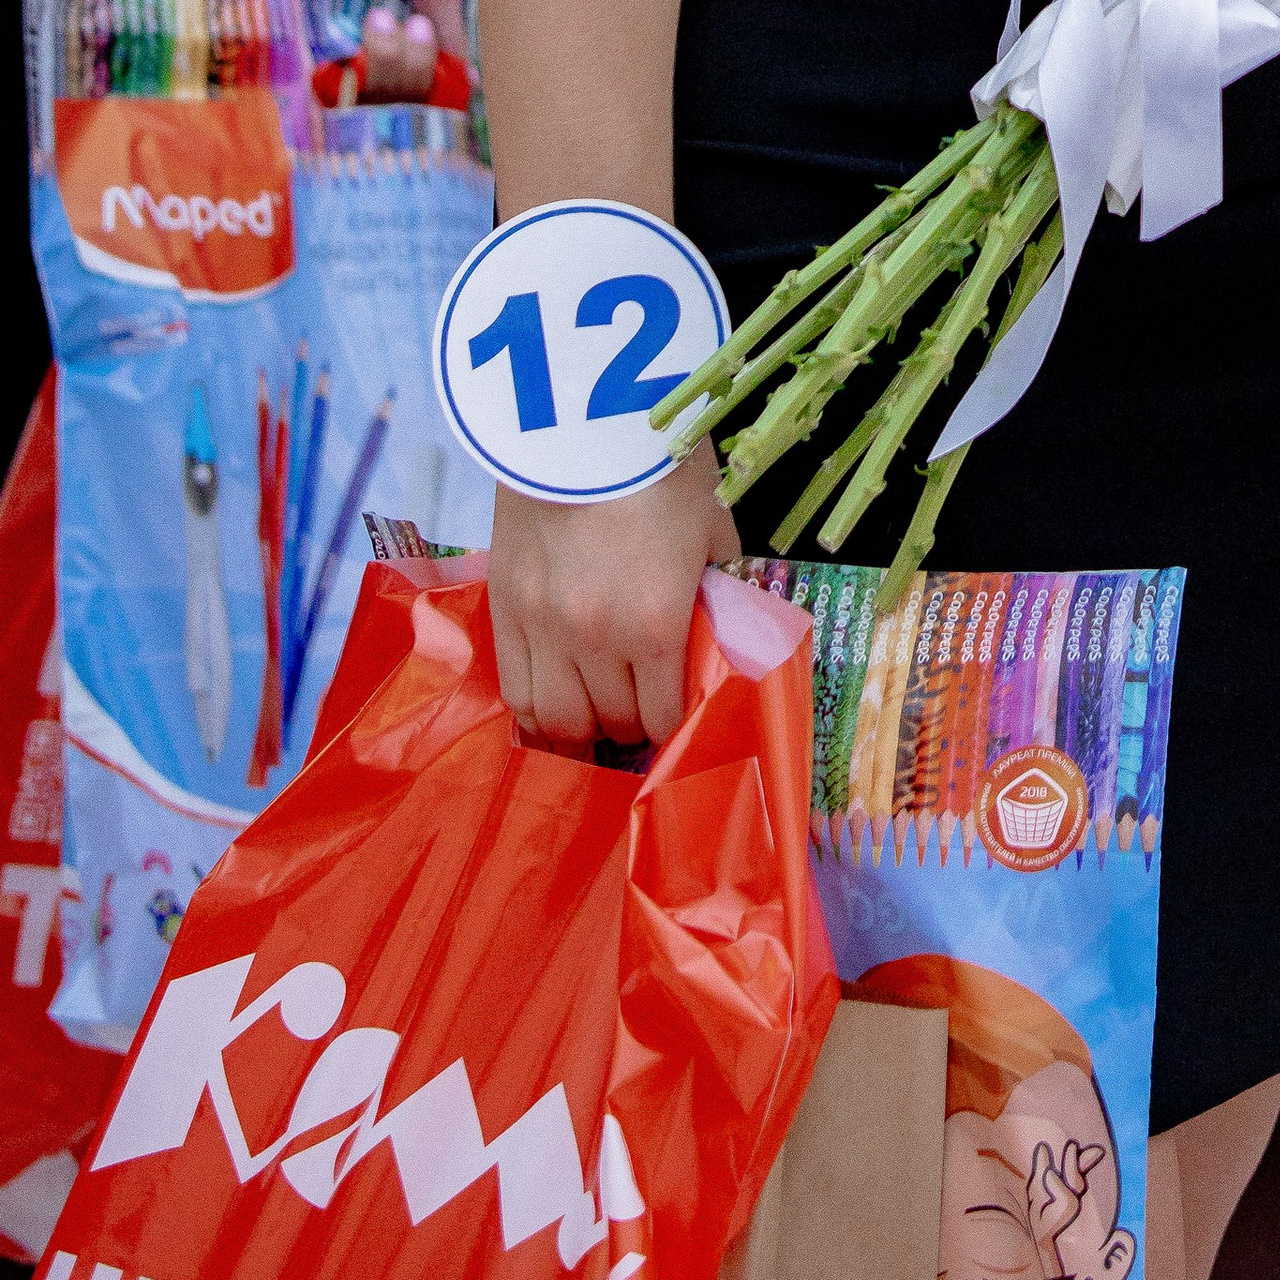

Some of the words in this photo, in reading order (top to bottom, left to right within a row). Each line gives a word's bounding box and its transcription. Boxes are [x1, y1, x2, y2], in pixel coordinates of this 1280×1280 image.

[101, 183, 277, 241] Maped
[468, 274, 692, 433] 12
[993, 749, 1036, 779] ЛАУРЕАТ
[1019, 786, 1048, 799] 2018
